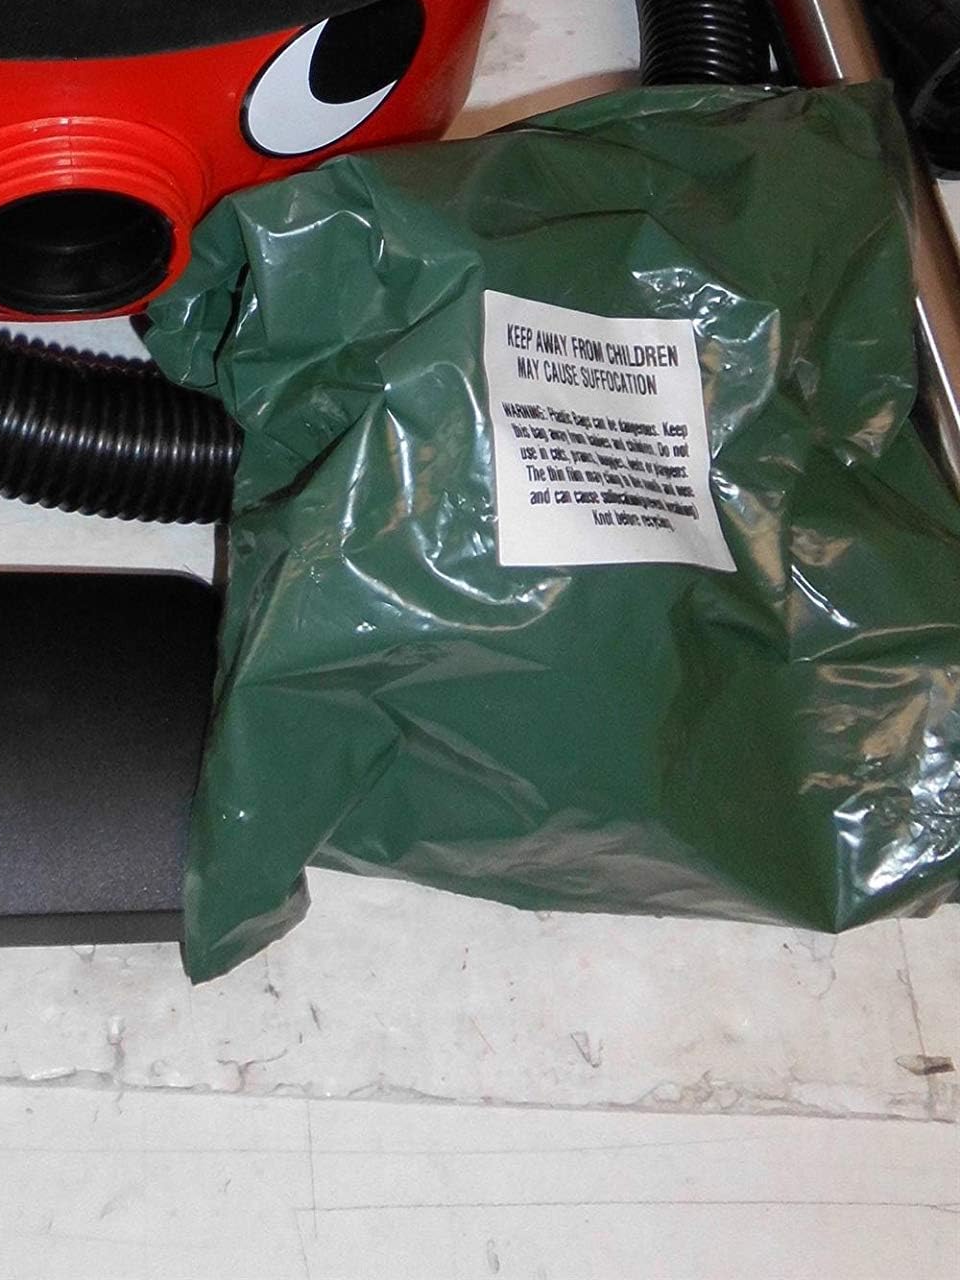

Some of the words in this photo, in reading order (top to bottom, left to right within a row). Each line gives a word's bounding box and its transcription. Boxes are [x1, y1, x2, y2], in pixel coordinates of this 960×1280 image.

[507, 323, 532, 350] KEEP
[536, 330, 568, 356] AWAY
[571, 336, 605, 363] FROM
[606, 342, 679, 368] CHILDREN
[517, 356, 540, 380] MAY
[543, 360, 580, 387] CAUSE
[580, 366, 657, 395] SUFFOCATION
[662, 421, 688, 440] Keep
[520, 447, 537, 460] use
[539, 445, 549, 460] in
[657, 442, 670, 457] Do
[673, 443, 689, 457] not
[526, 465, 546, 481] The
[530, 488, 550, 505] and
